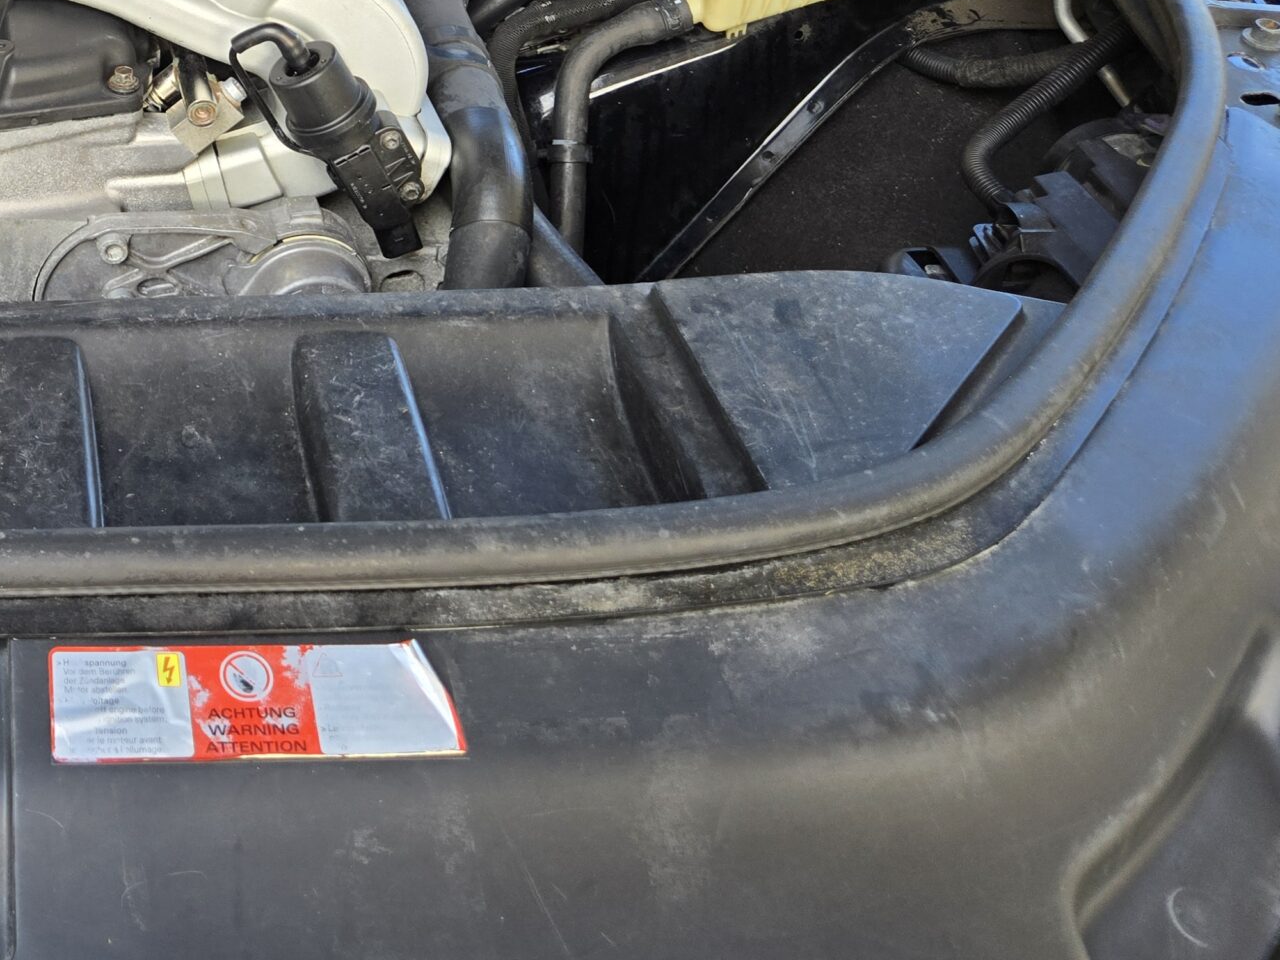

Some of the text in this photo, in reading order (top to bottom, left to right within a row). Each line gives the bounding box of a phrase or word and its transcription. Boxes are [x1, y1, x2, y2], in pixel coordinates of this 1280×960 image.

[63, 658, 127, 667] Hspannung
[208, 706, 296, 720] ACHTUNG
[208, 723, 300, 736] WARNING
[206, 740, 307, 753] ATTENTION
